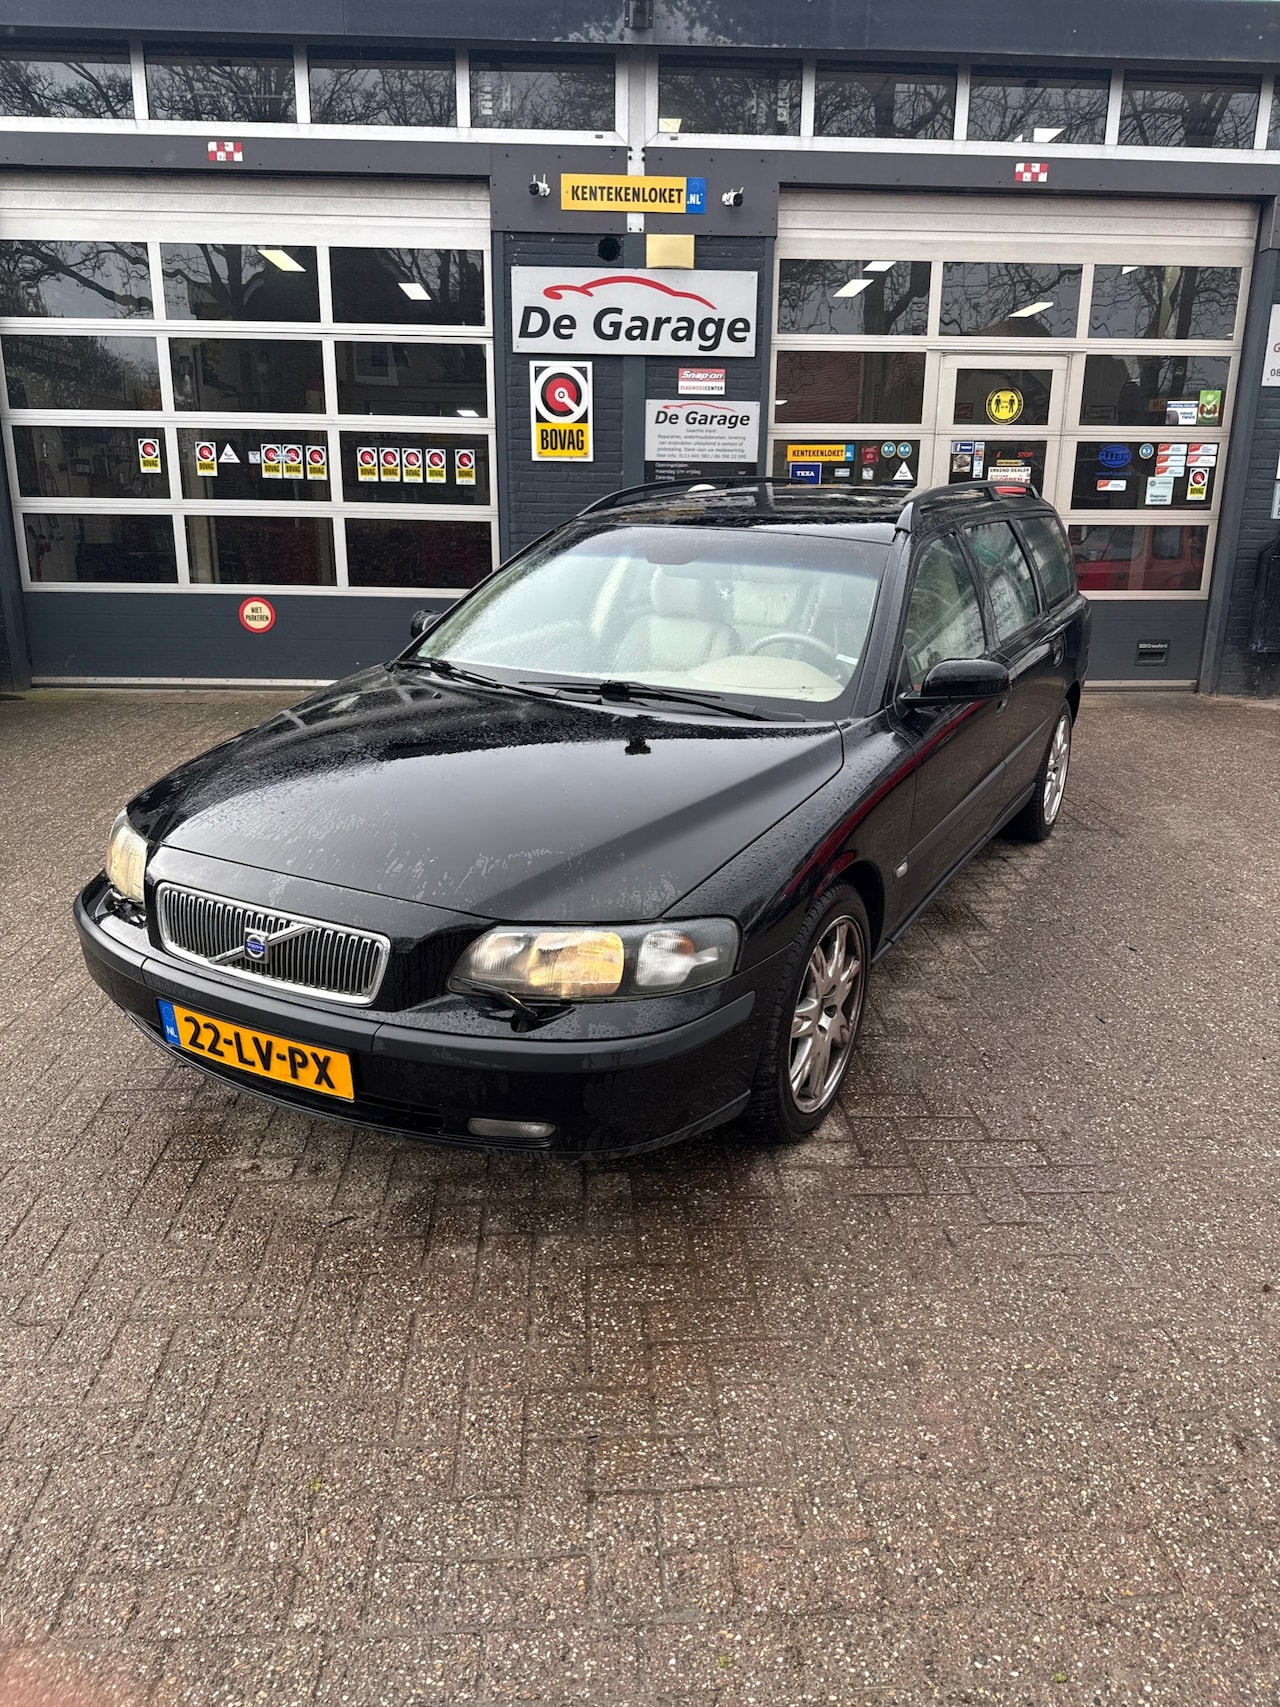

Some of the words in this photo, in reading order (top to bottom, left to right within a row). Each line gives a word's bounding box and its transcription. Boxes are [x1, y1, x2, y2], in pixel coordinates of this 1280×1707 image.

[571, 185, 684, 204] KENTEKENLOKET
[518, 306, 577, 340] De
[593, 307, 751, 351] Garage
[681, 370, 724, 381] Snap-on
[655, 410, 679, 424] De
[685, 411, 750, 429] Garage
[541, 429, 584, 451] BOVAG
[792, 449, 844, 457] KENTEKENLOKET
[166, 1025, 178, 1038] NL
[184, 1016, 336, 1089] 22-LV-PX
